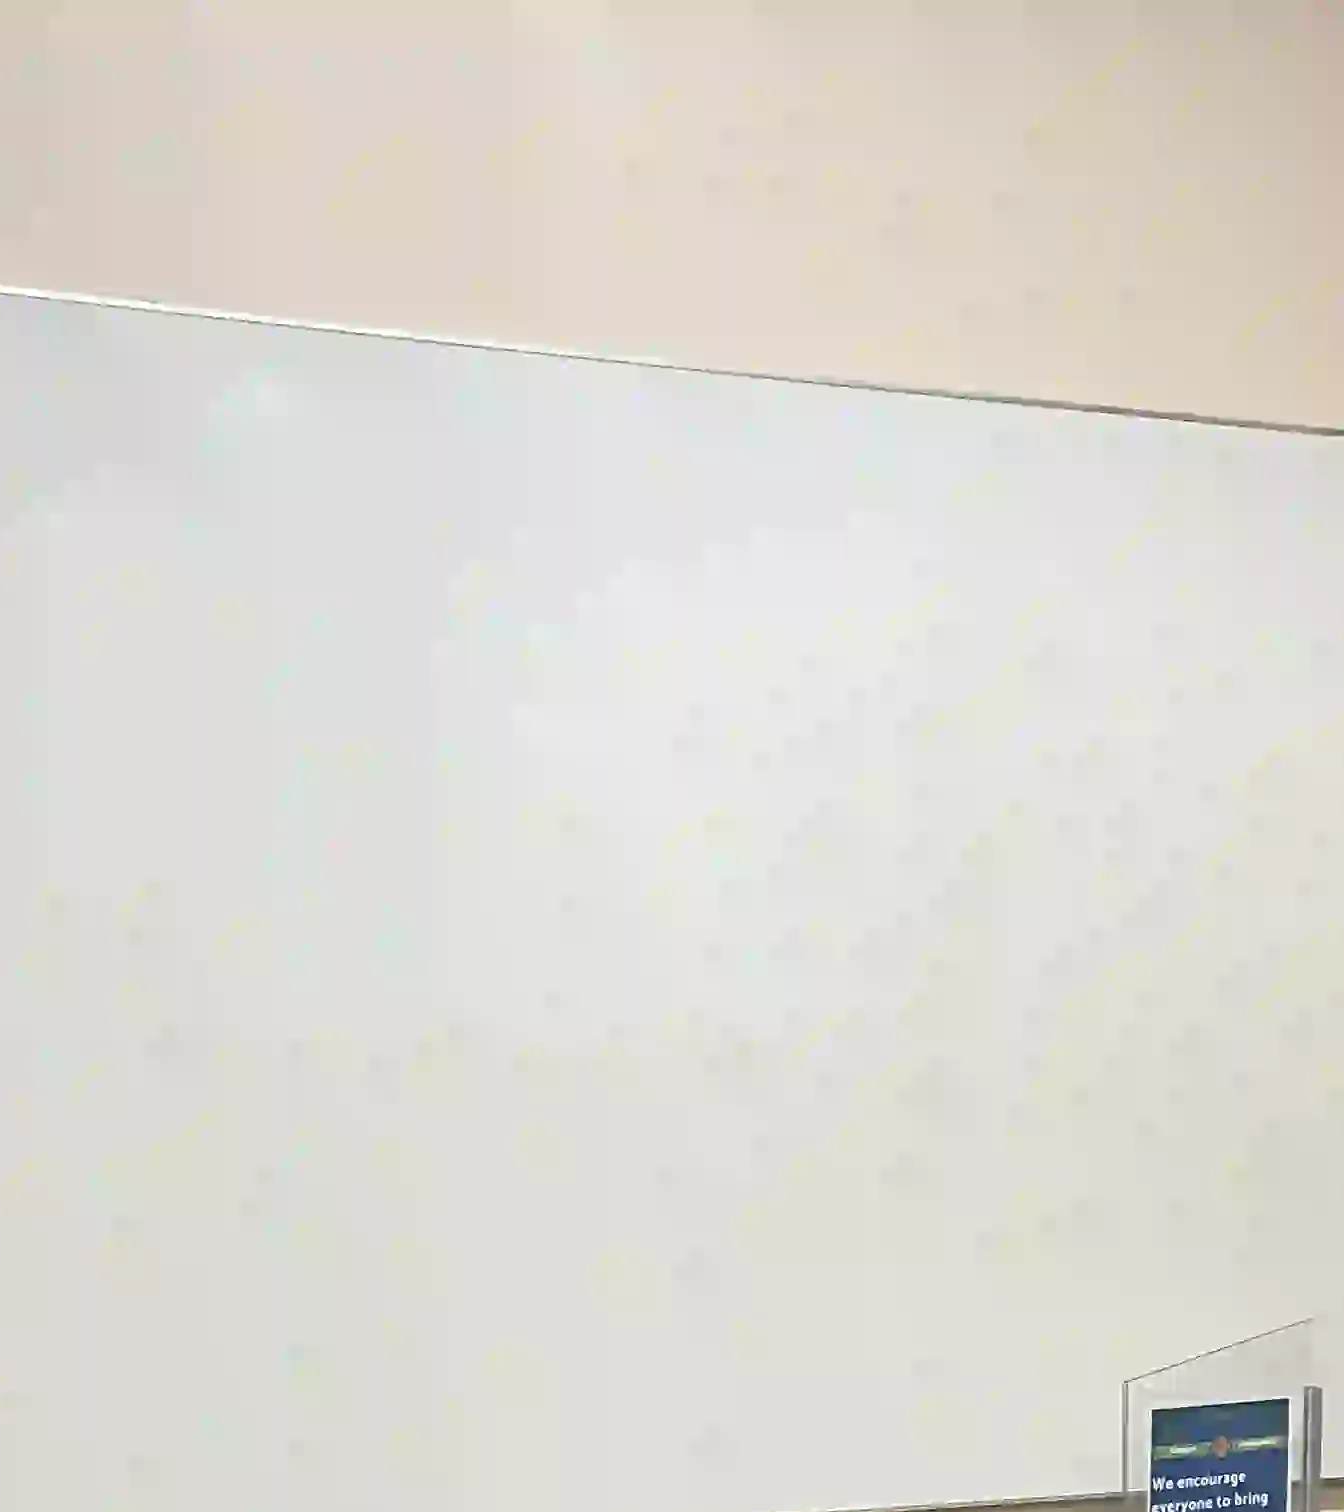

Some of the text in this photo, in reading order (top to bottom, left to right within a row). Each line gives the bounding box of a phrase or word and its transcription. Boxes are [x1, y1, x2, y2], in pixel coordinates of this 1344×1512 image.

[1152, 1471, 1246, 1491] We encourage
[1217, 1495, 1232, 1508] to
[1235, 1491, 1269, 1507] bring
